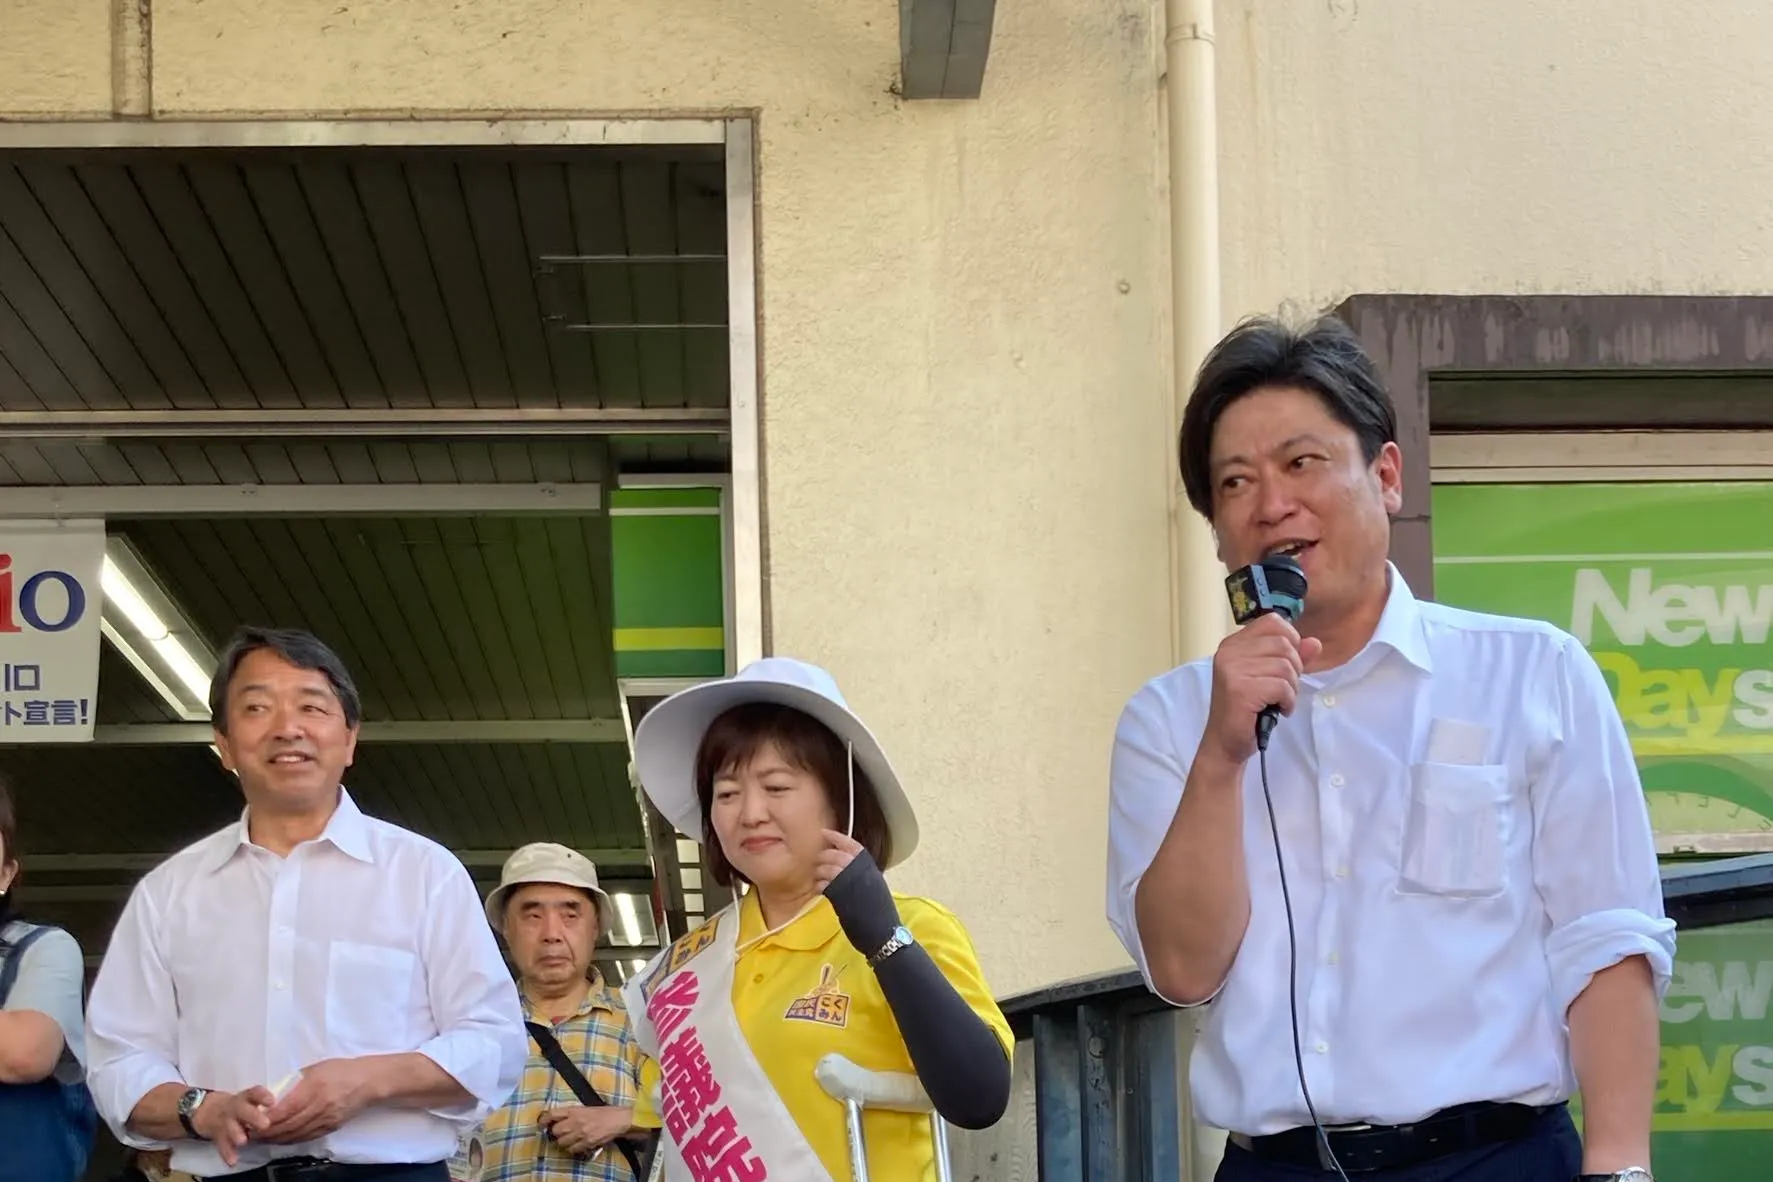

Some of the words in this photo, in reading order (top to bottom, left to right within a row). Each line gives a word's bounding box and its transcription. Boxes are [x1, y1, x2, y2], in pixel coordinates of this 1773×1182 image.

[1571, 568, 1773, 647] New
[0, 699, 88, 725] ト宣言!
[1660, 960, 1773, 1024] ew
[1654, 1043, 1773, 1116] ays
